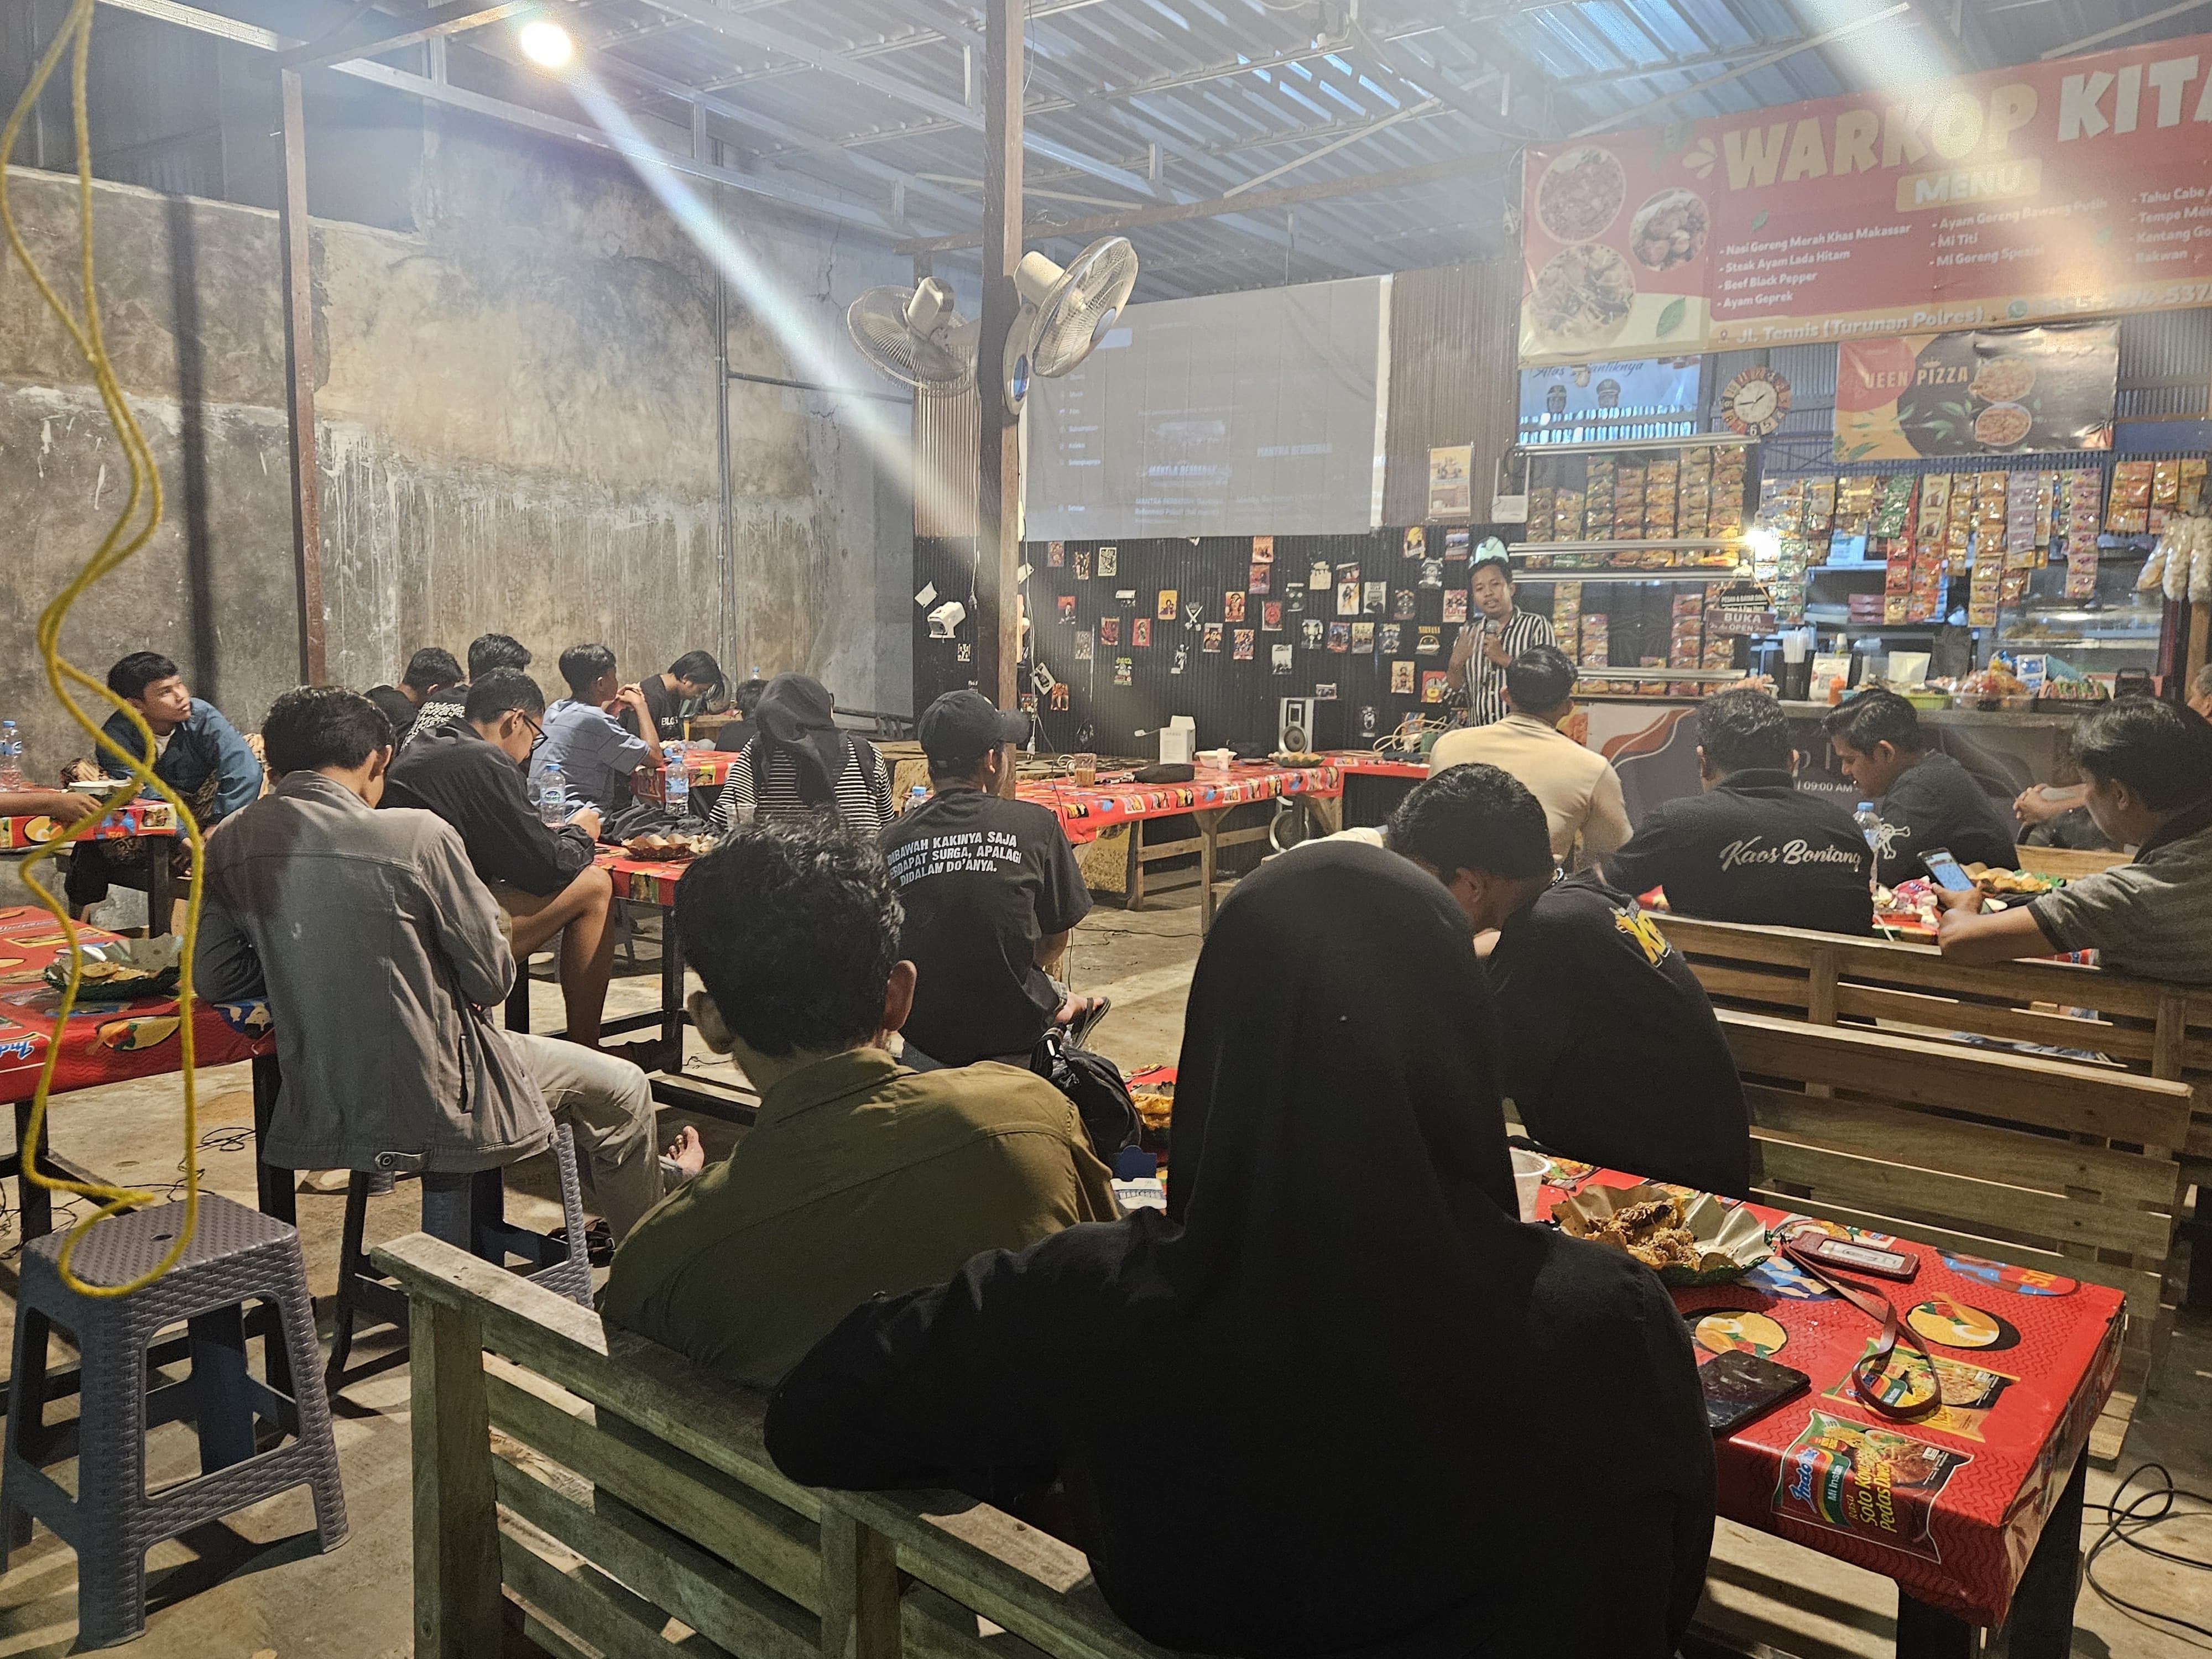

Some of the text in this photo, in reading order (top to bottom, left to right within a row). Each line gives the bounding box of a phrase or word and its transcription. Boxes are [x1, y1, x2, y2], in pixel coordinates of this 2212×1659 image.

[1722, 83, 2039, 192] WARKOP
[1914, 167, 2022, 205] MENU
[2140, 186, 2205, 204] Tahu Cabe
[1939, 216, 1974, 230] Ayam
[1976, 211, 2020, 224] Goreng
[2138, 211, 2182, 225] Tempe
[1726, 224, 1913, 256] Nasi Goreng Merah Khas Makassar
[1938, 232, 1979, 248] Mi Titi
[2136, 229, 2191, 243] Kentang
[1725, 249, 1850, 273] Steak Ayam Lada Hitam
[1936, 254, 1954, 267] Mi
[1955, 249, 1999, 265] Goreng
[1724, 272, 1817, 290] Beef Black Pepper
[1722, 291, 1793, 310] Ayam Geprek
[1736, 305, 1984, 343] Jl. Tennis (Turunan Polres)
[1867, 366, 1969, 389] UEEN PIZZA
[1749, 424, 1757, 437] 6
[1724, 612, 1761, 623] BUKA
[1729, 623, 1754, 632] OPEN
[1835, 782, 1854, 794] AM
[887, 831, 1017, 866] DIBAWAH KAKINYA SAJA
[932, 847, 972, 862] SURGA,
[977, 846, 1022, 864] APALAGI
[1720, 836, 1863, 873] Kaos Bontang
[900, 859, 998, 886] DIDALAM DO'ANYA.
[1827, 1488, 1837, 1501] Mi
[1846, 1494, 1859, 1520] Rasa
[1857, 1490, 1878, 1527] Soto
[1876, 1486, 1898, 1533] Pedas
